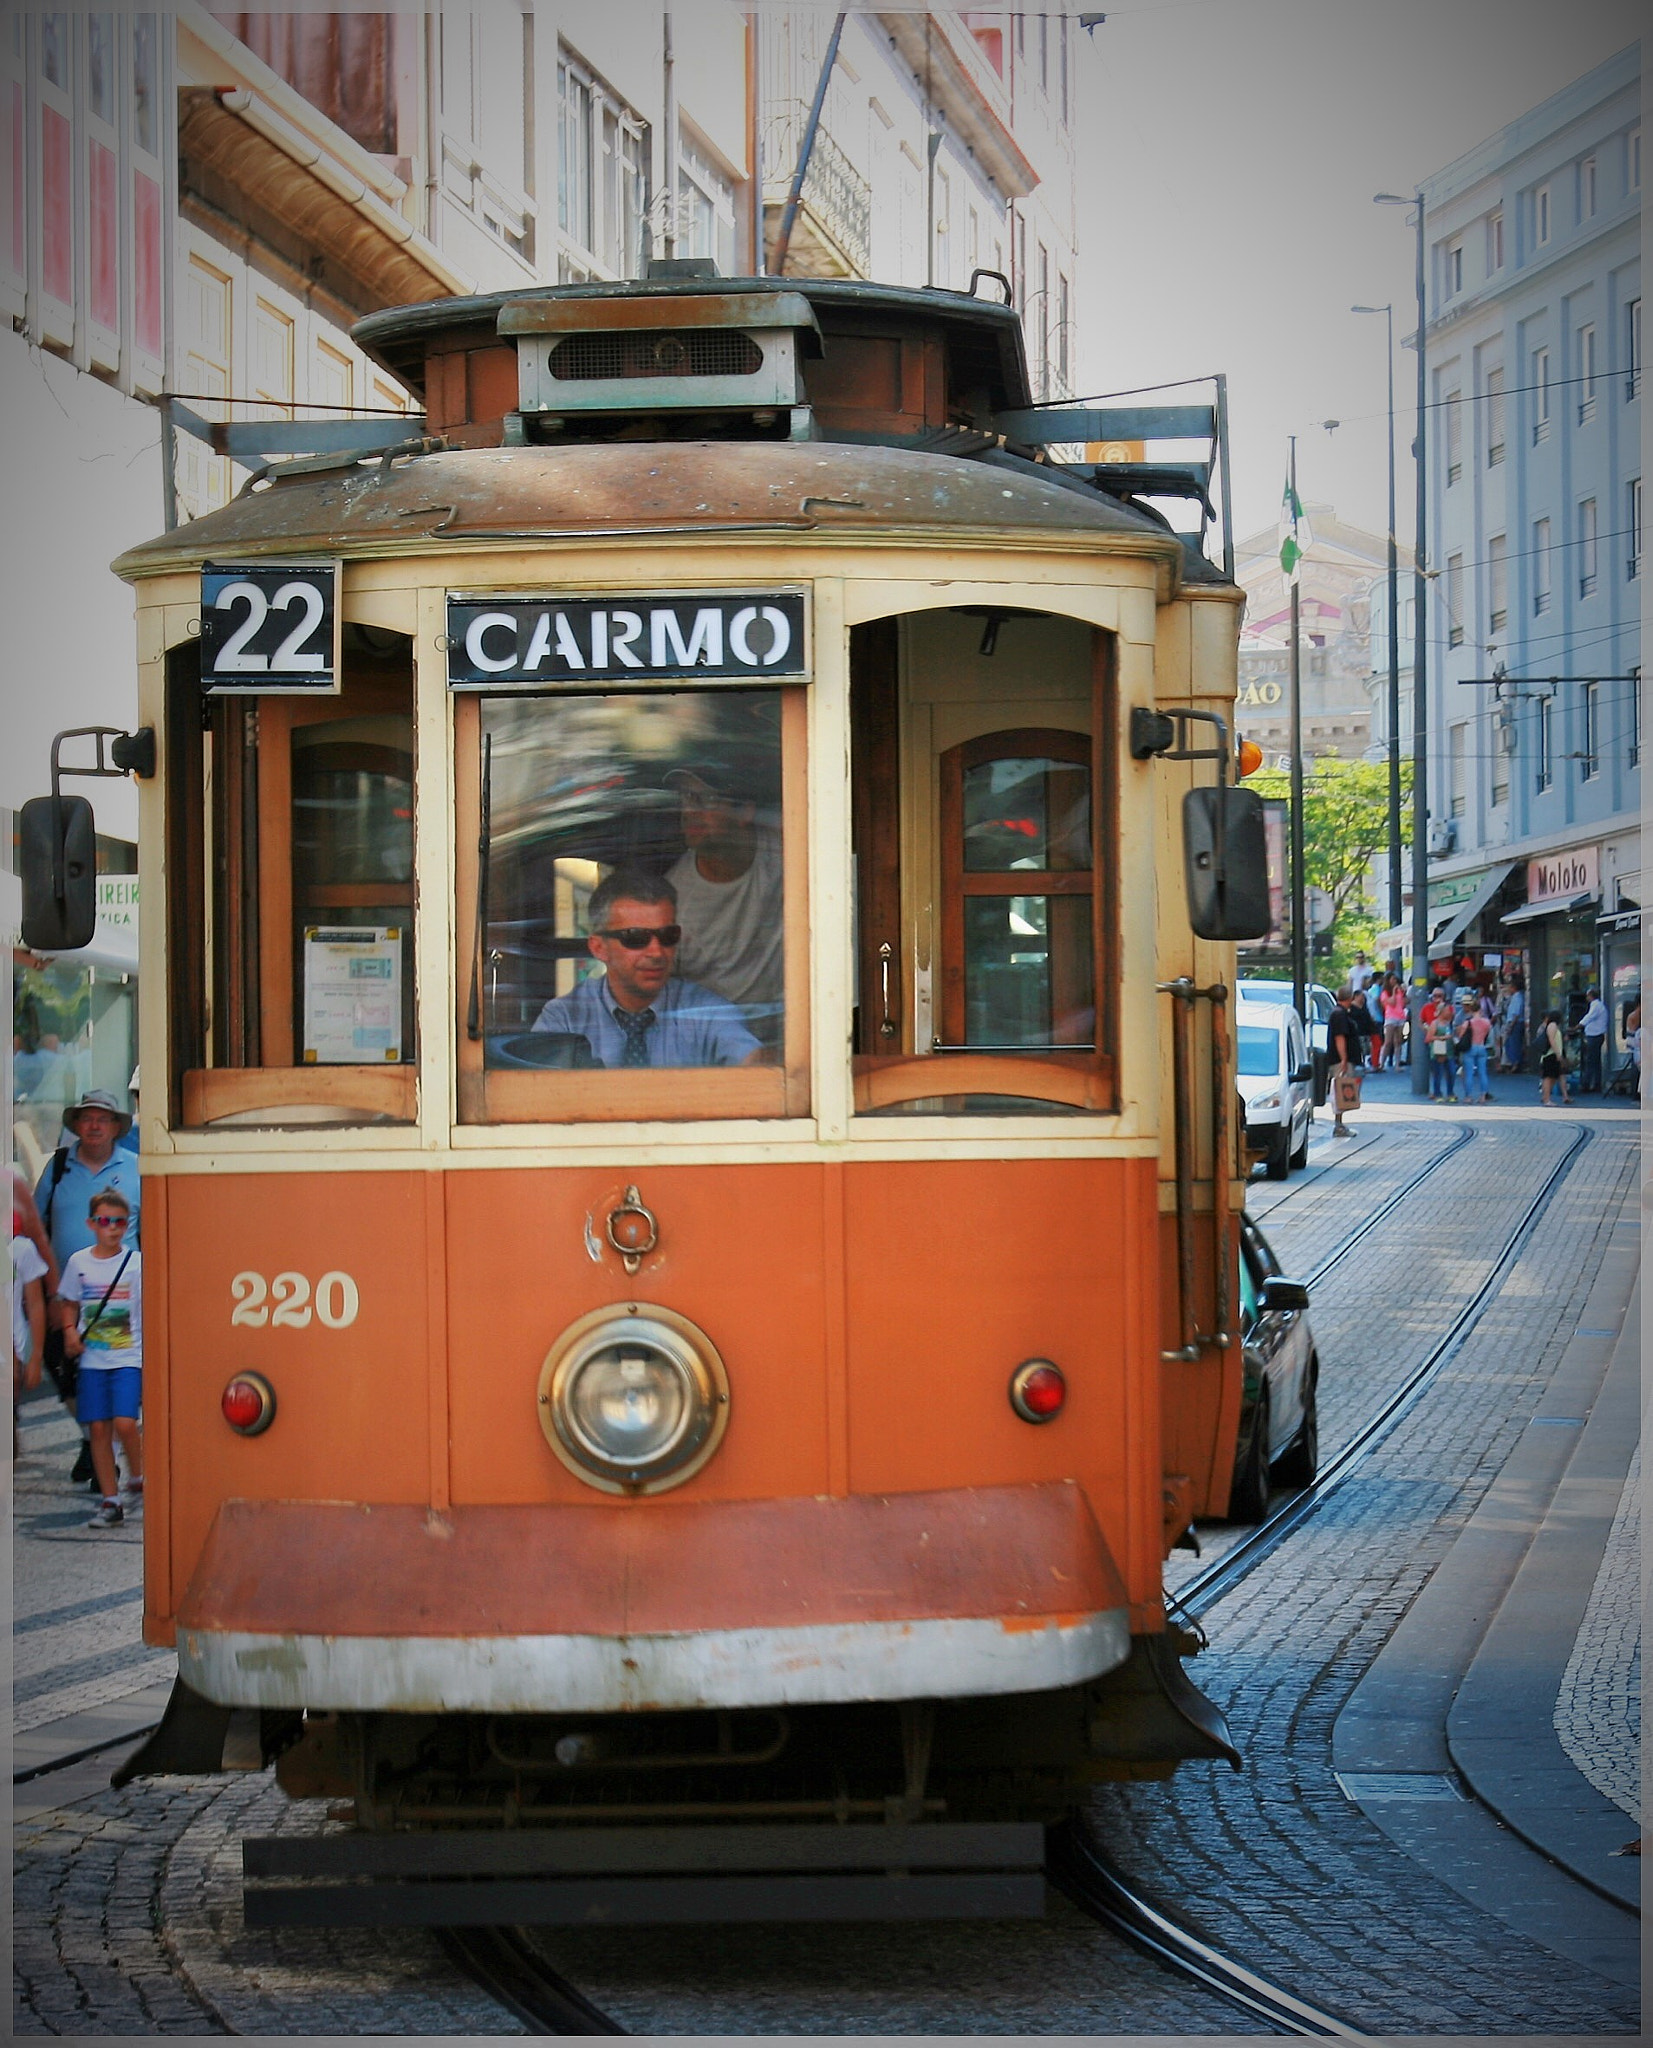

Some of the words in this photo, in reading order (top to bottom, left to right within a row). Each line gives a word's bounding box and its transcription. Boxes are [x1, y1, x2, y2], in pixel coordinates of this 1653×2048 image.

[213, 581, 325, 672] 22
[465, 606, 791, 673] CARMO
[1235, 676, 1281, 705] ÃO
[1538, 857, 1587, 896] Moloko
[231, 1270, 359, 1329] 220
